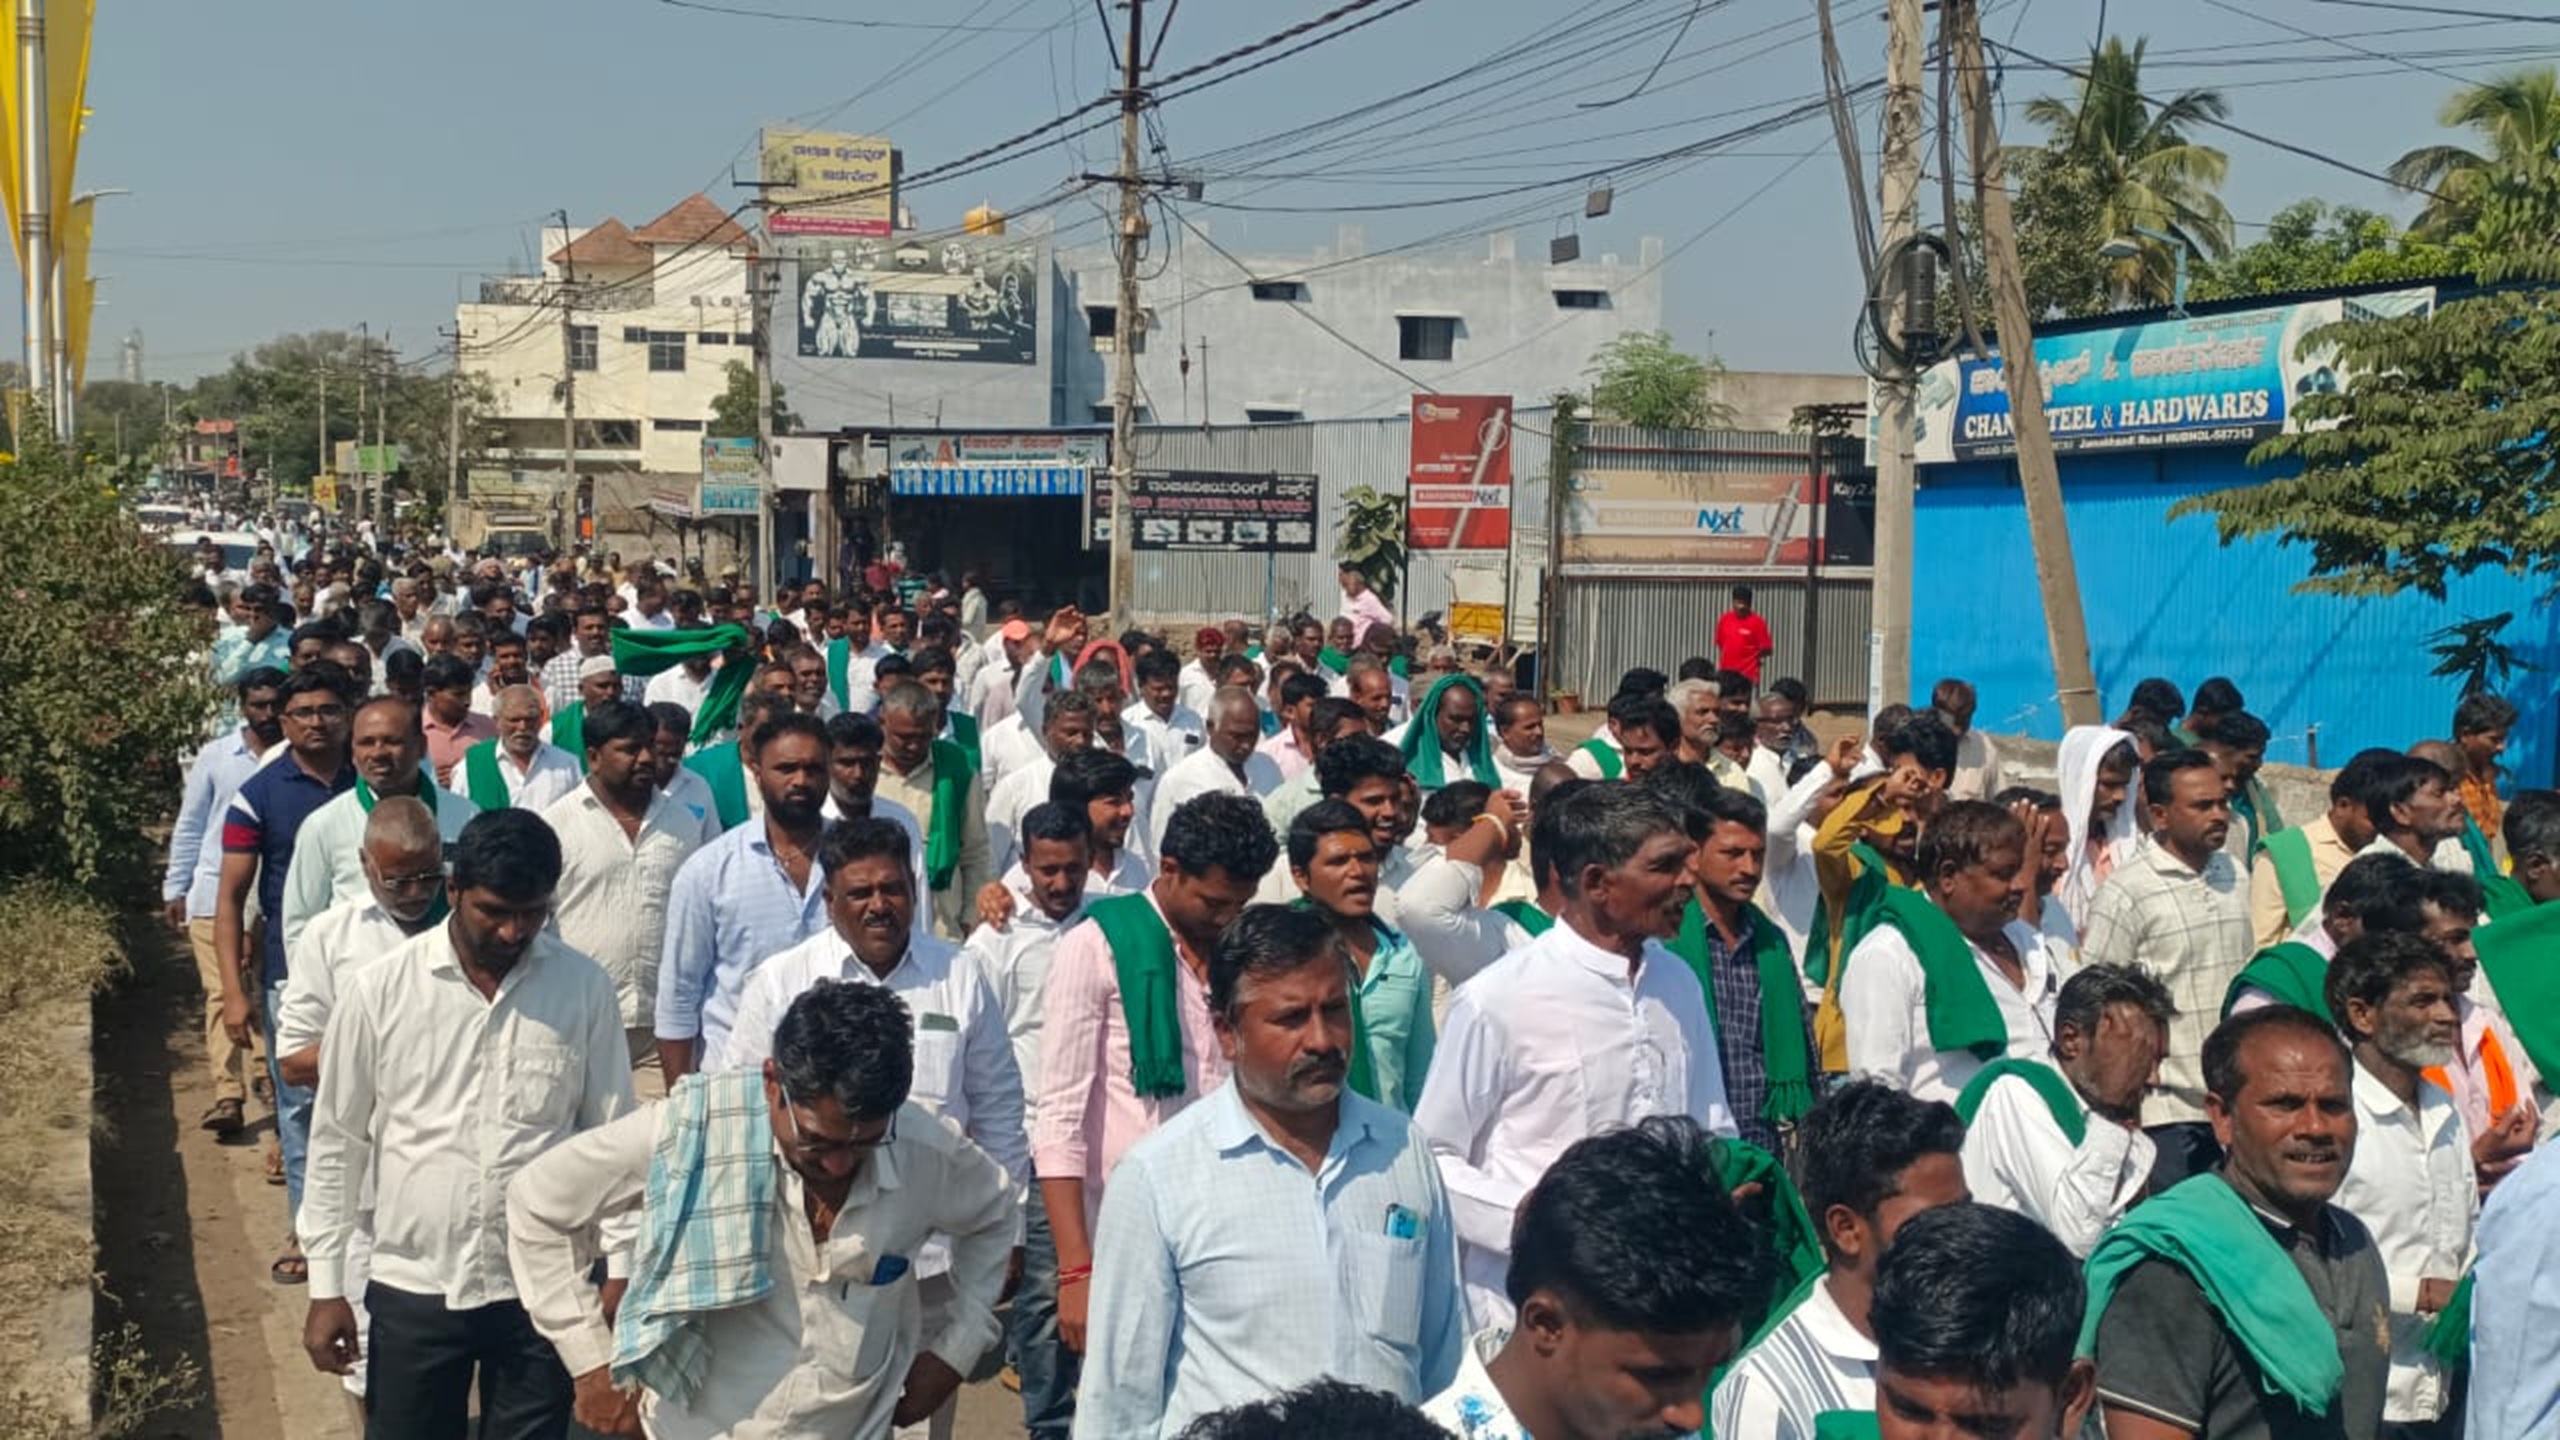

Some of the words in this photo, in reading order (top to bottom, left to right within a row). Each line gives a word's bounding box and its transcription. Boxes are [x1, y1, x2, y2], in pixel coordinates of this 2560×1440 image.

[1964, 412, 2016, 440] CHAN
[2044, 404, 2097, 433] TEEL
[2101, 404, 2114, 429] &
[2118, 390, 2269, 427] HARDWARES
[1697, 505, 1745, 534] Nxt
